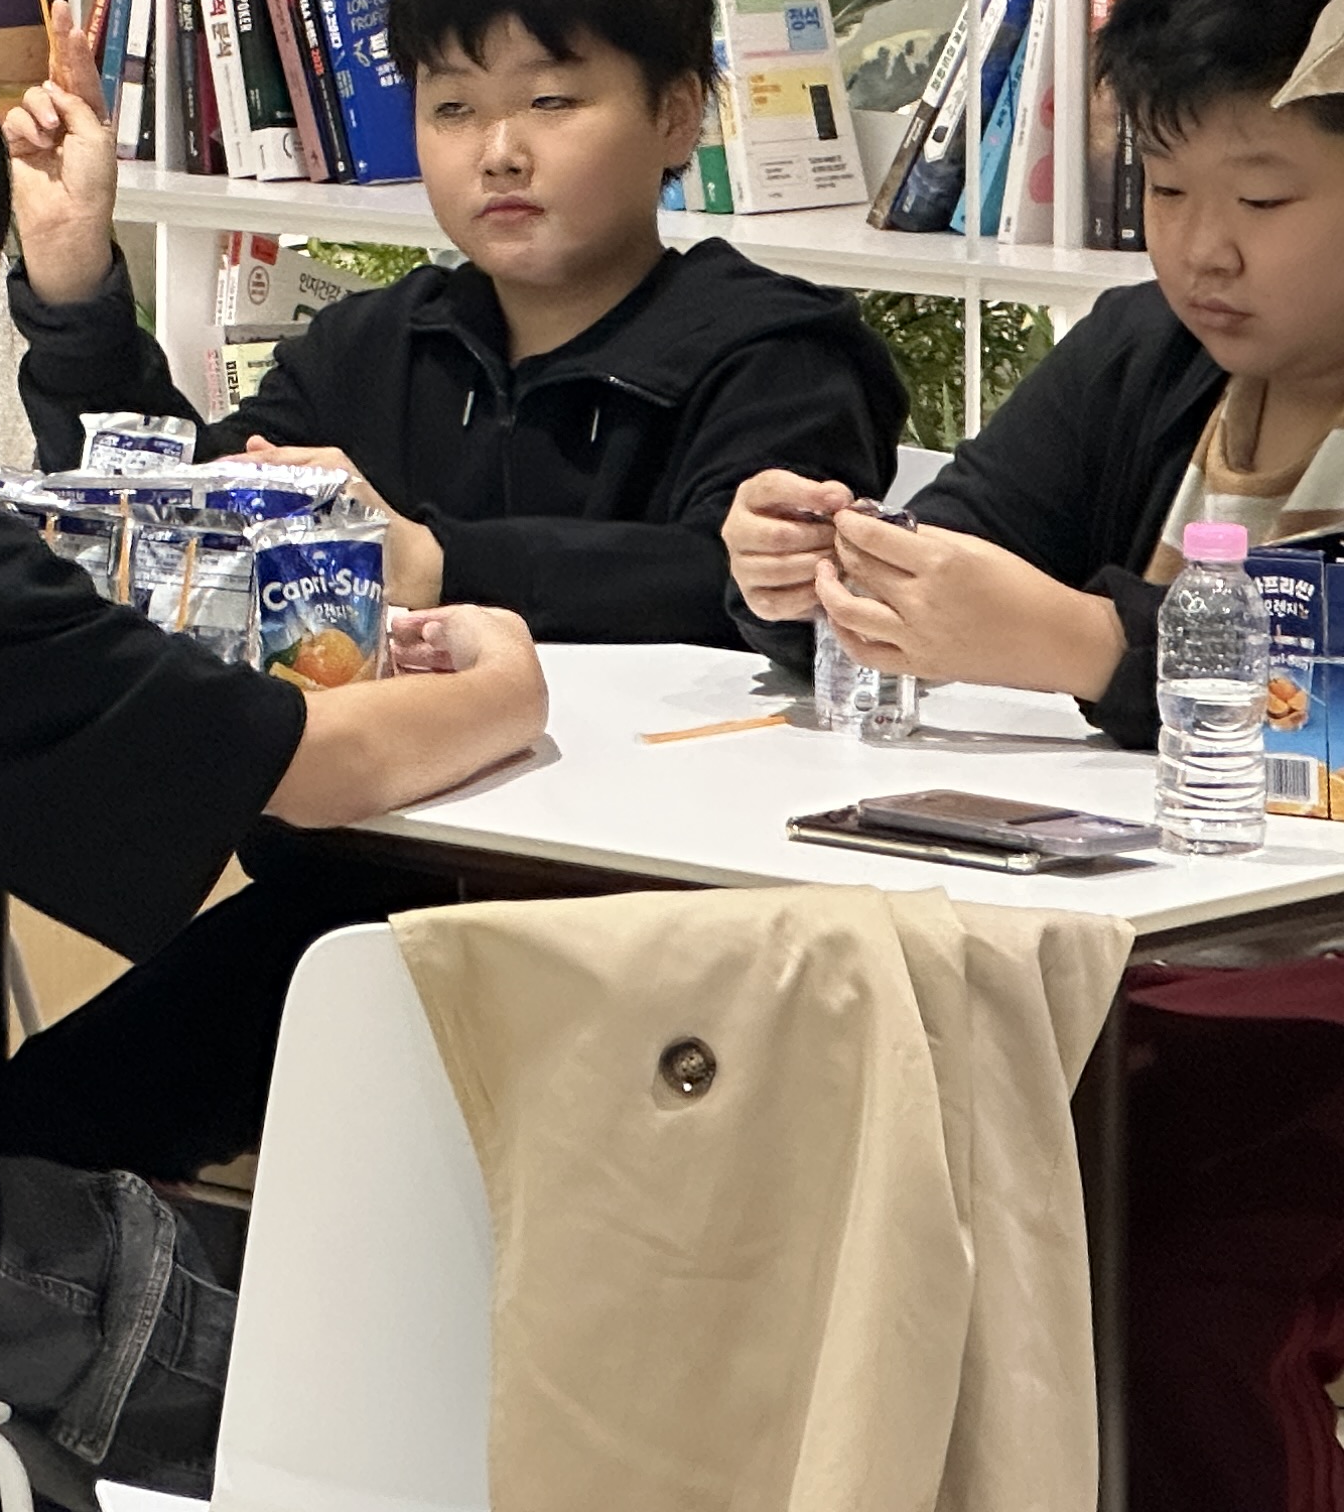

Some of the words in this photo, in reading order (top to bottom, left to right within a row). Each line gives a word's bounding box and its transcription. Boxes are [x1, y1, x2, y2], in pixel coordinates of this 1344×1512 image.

[789, 8, 820, 30] 정석
[212, 22, 233, 59] 분석
[299, 272, 341, 301] 인지건강
[262, 568, 382, 611] Capri-Sun
